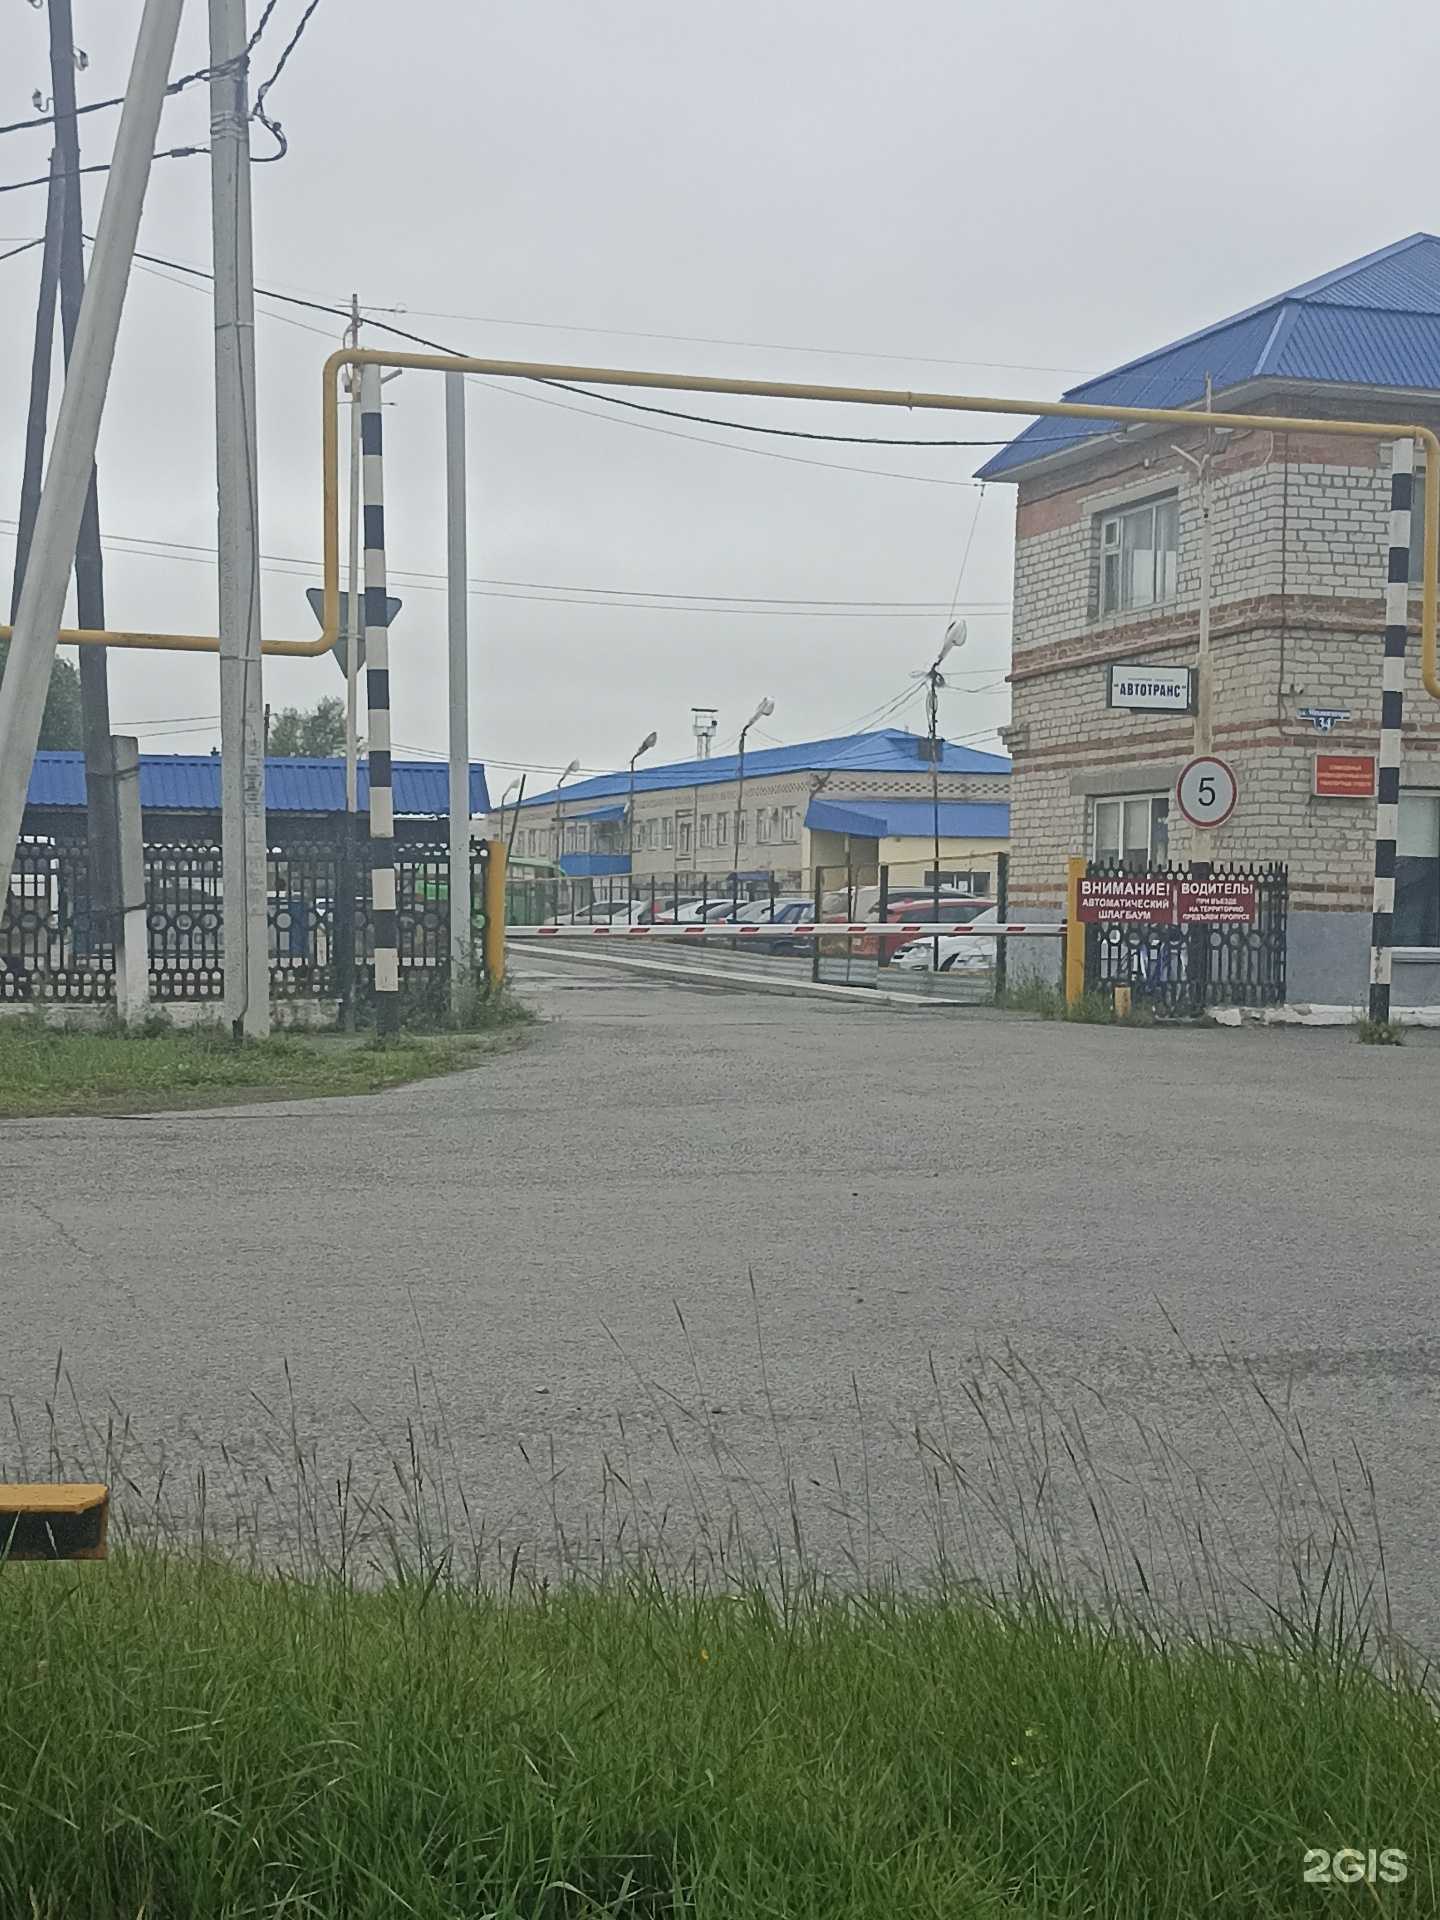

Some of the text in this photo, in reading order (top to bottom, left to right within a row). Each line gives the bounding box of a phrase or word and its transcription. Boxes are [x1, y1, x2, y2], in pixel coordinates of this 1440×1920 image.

[1113, 682, 1186, 698] "АВТОТРАНС"
[1198, 777, 1216, 807] 5
[1081, 880, 1170, 896] ВНИМАНИЕ!
[1181, 882, 1254, 896] ВОДИТЕЛЬ!
[1082, 897, 1169, 909] АВТОМАТИЧЕСКИЙ
[1200, 905, 1244, 913] ТЕРРИТОРИЮ
[1098, 909, 1151, 920] ШЛАГБАУМ
